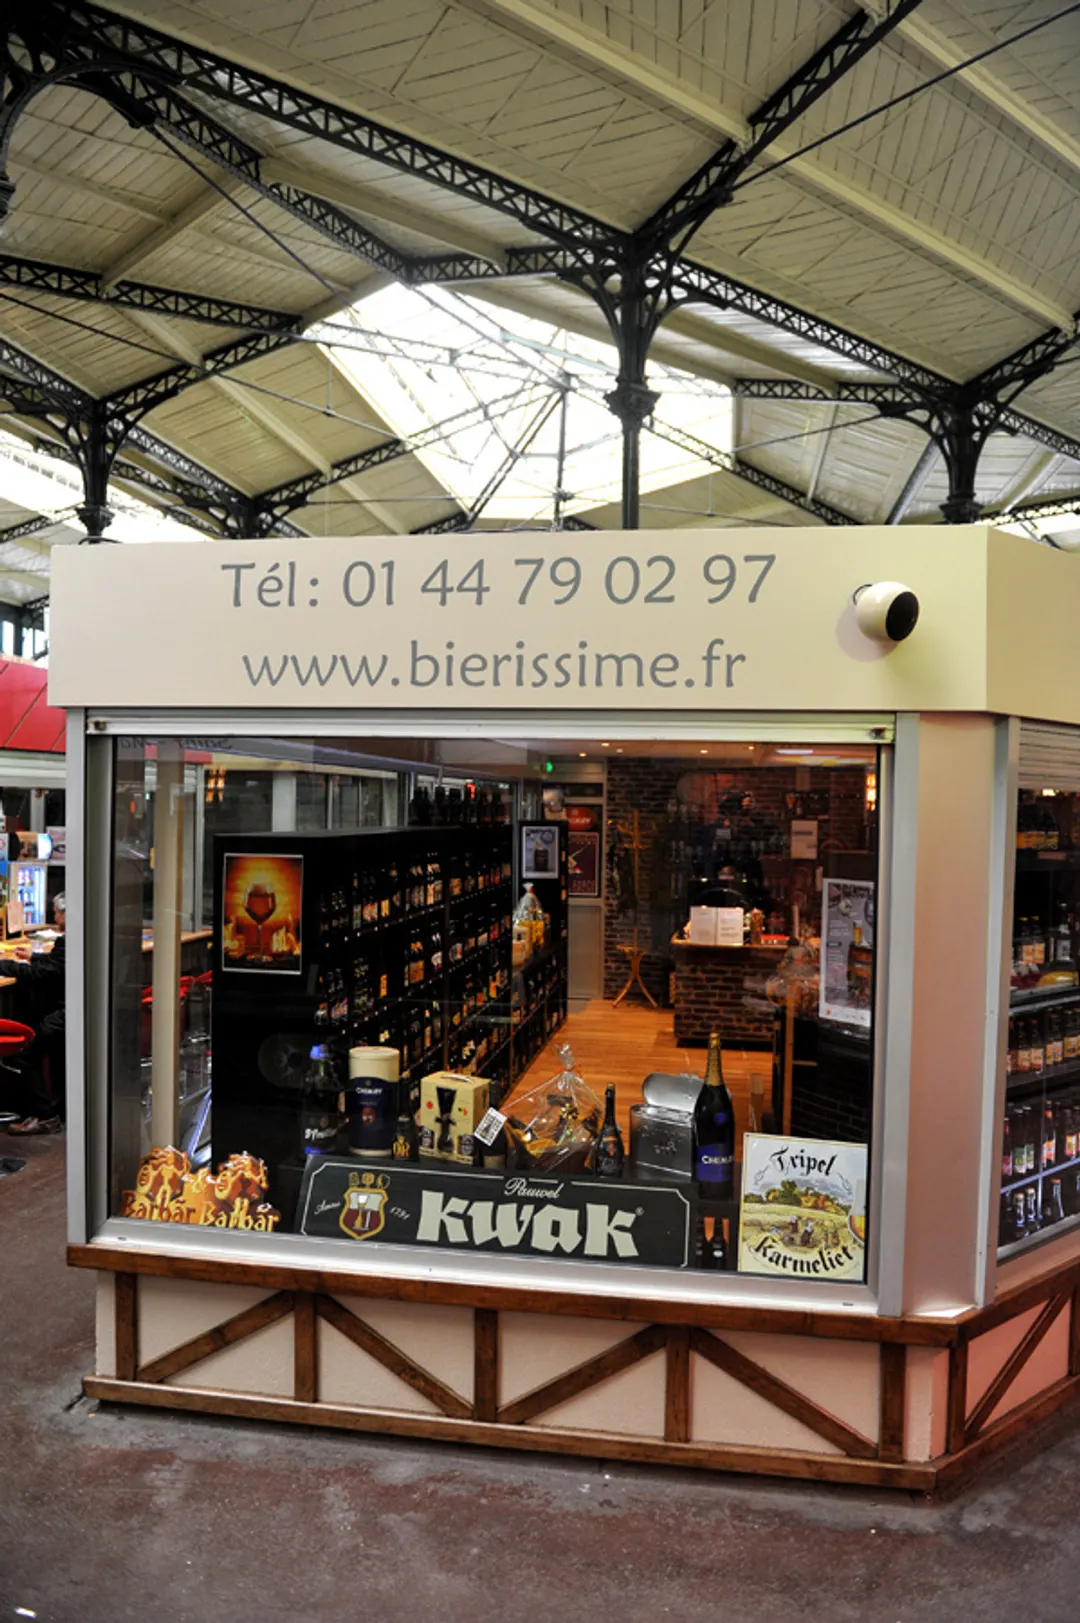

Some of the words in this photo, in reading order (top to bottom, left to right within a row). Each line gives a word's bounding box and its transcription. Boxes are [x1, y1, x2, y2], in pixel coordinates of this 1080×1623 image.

[342, 559, 395, 608] 01
[420, 558, 491, 607] 44
[514, 556, 582, 606] 79
[604, 555, 676, 605] 02
[703, 553, 777, 605] 97
[242, 638, 747, 689] www.bierissime.fr
[768, 1145, 838, 1176] Tripel
[503, 1176, 566, 1199] Pauwel
[753, 1235, 854, 1274] Karmeliet
